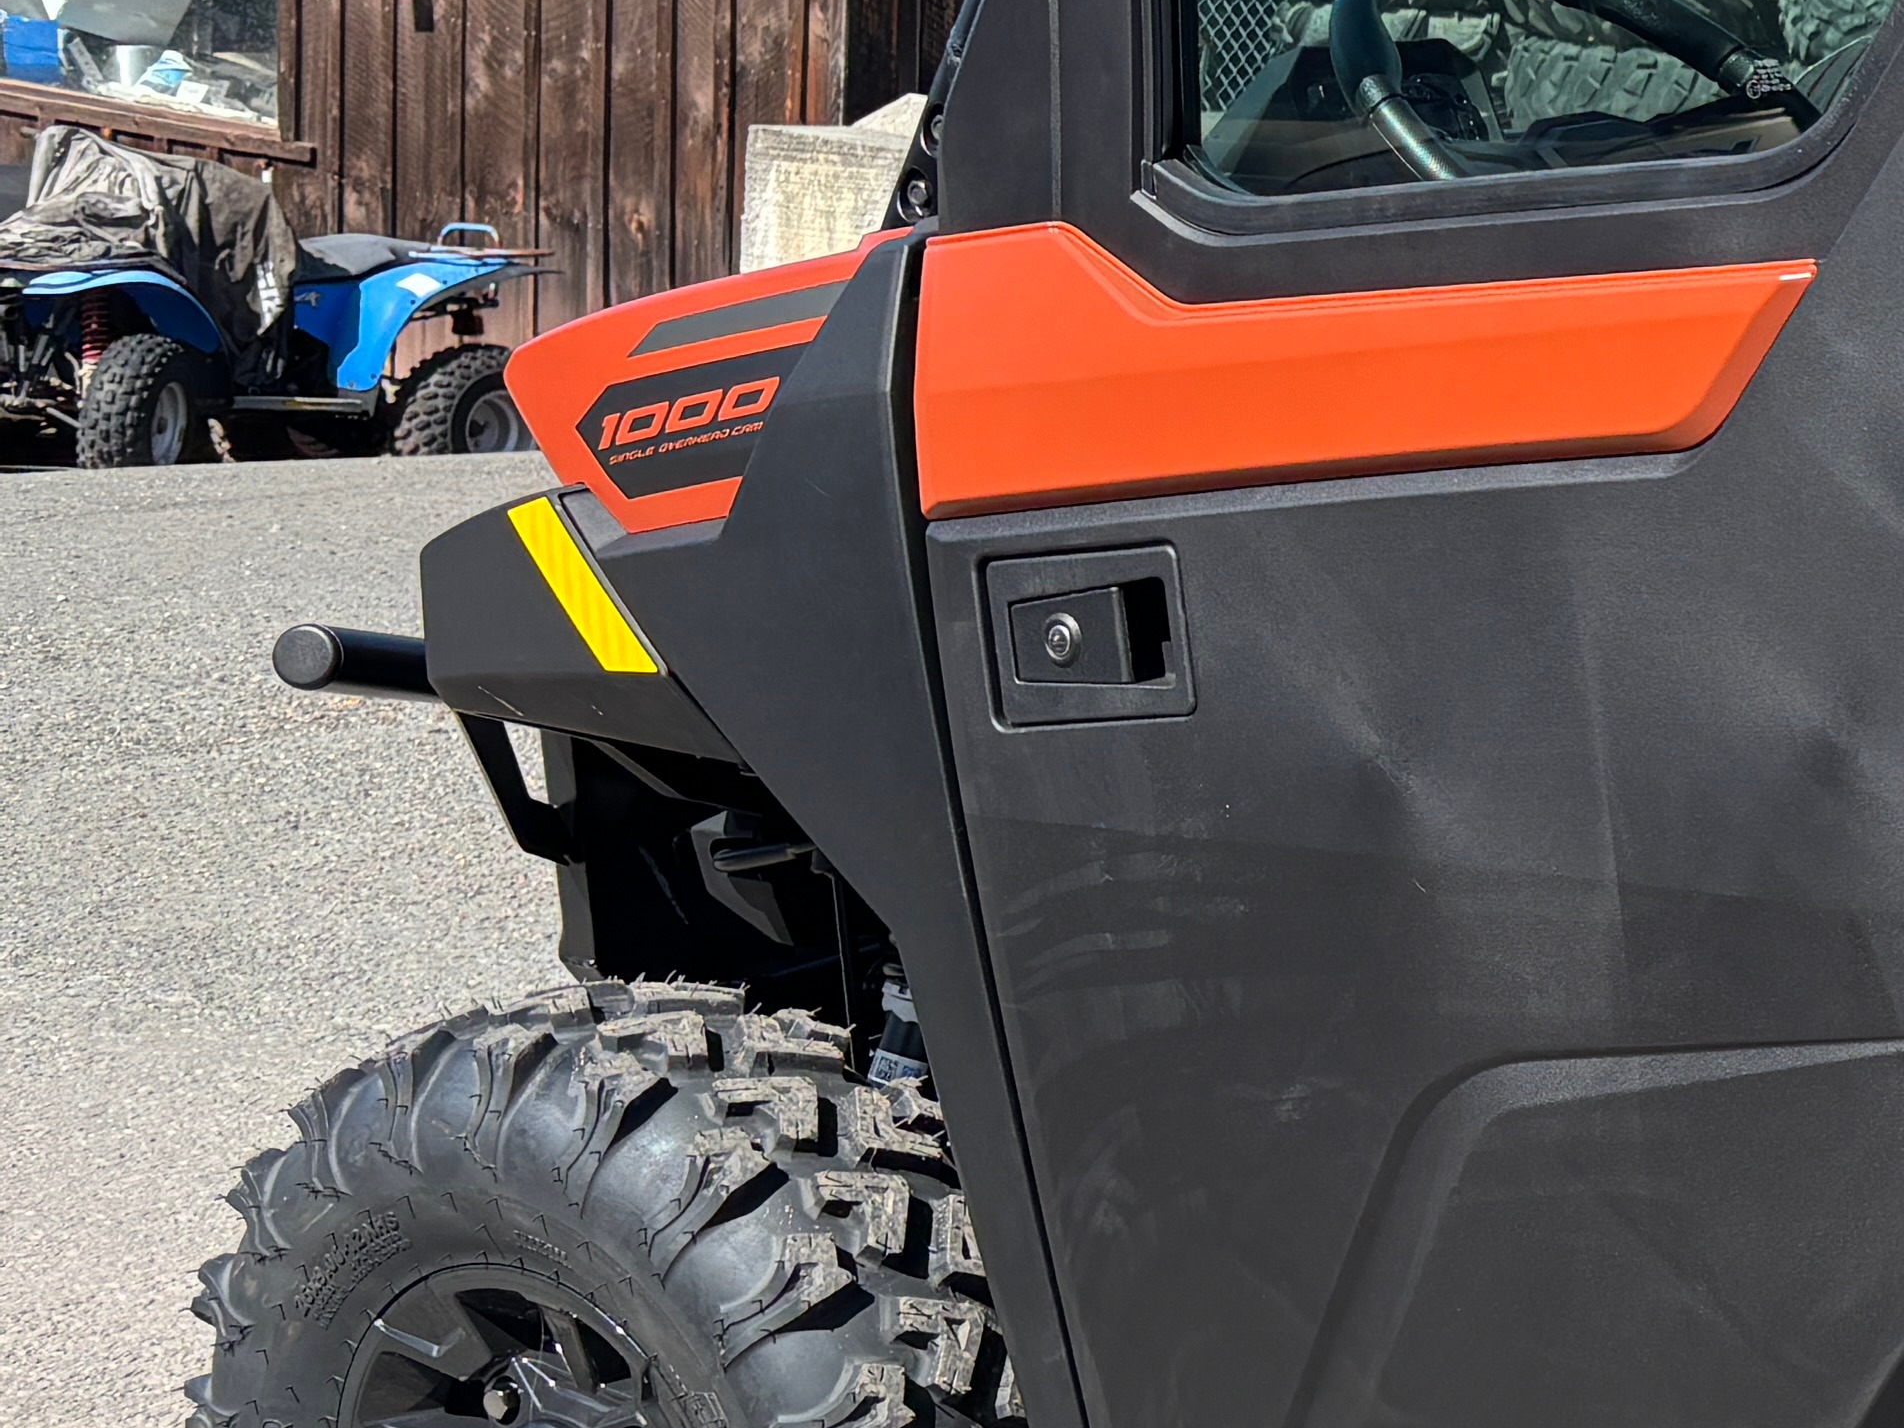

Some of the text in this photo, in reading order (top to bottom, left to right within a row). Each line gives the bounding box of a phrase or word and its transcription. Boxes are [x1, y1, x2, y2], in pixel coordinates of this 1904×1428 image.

[598, 376, 780, 451] 1000
[609, 421, 764, 467] SINGLE OVERHEAD CAM
